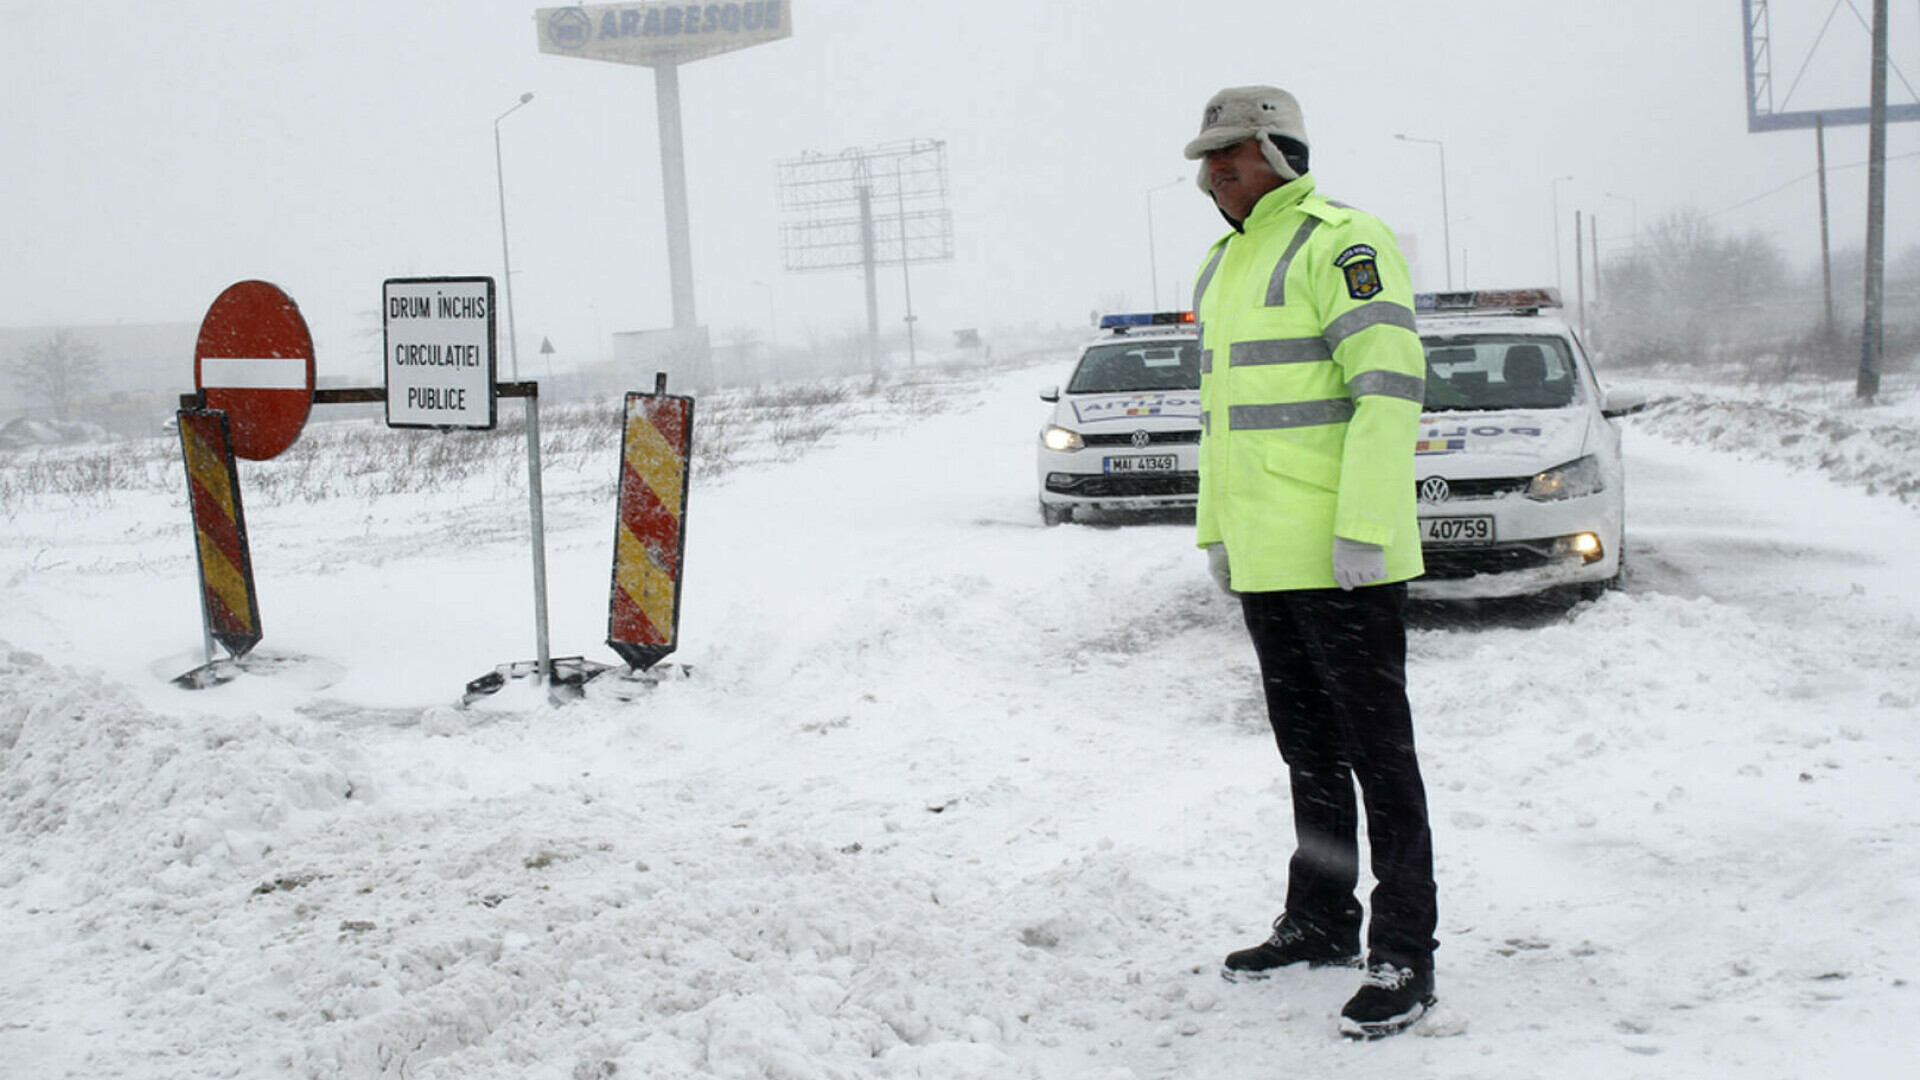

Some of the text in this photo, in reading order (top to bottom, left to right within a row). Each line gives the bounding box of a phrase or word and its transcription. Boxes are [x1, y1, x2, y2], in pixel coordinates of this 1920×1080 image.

[598, 0, 781, 40] ARABESQUE
[390, 290, 486, 319] DRUM ÎNCHIS
[408, 387, 466, 411] PUBLICE
[1112, 457, 1173, 471] MAI 41349
[1428, 520, 1488, 539] 40759
